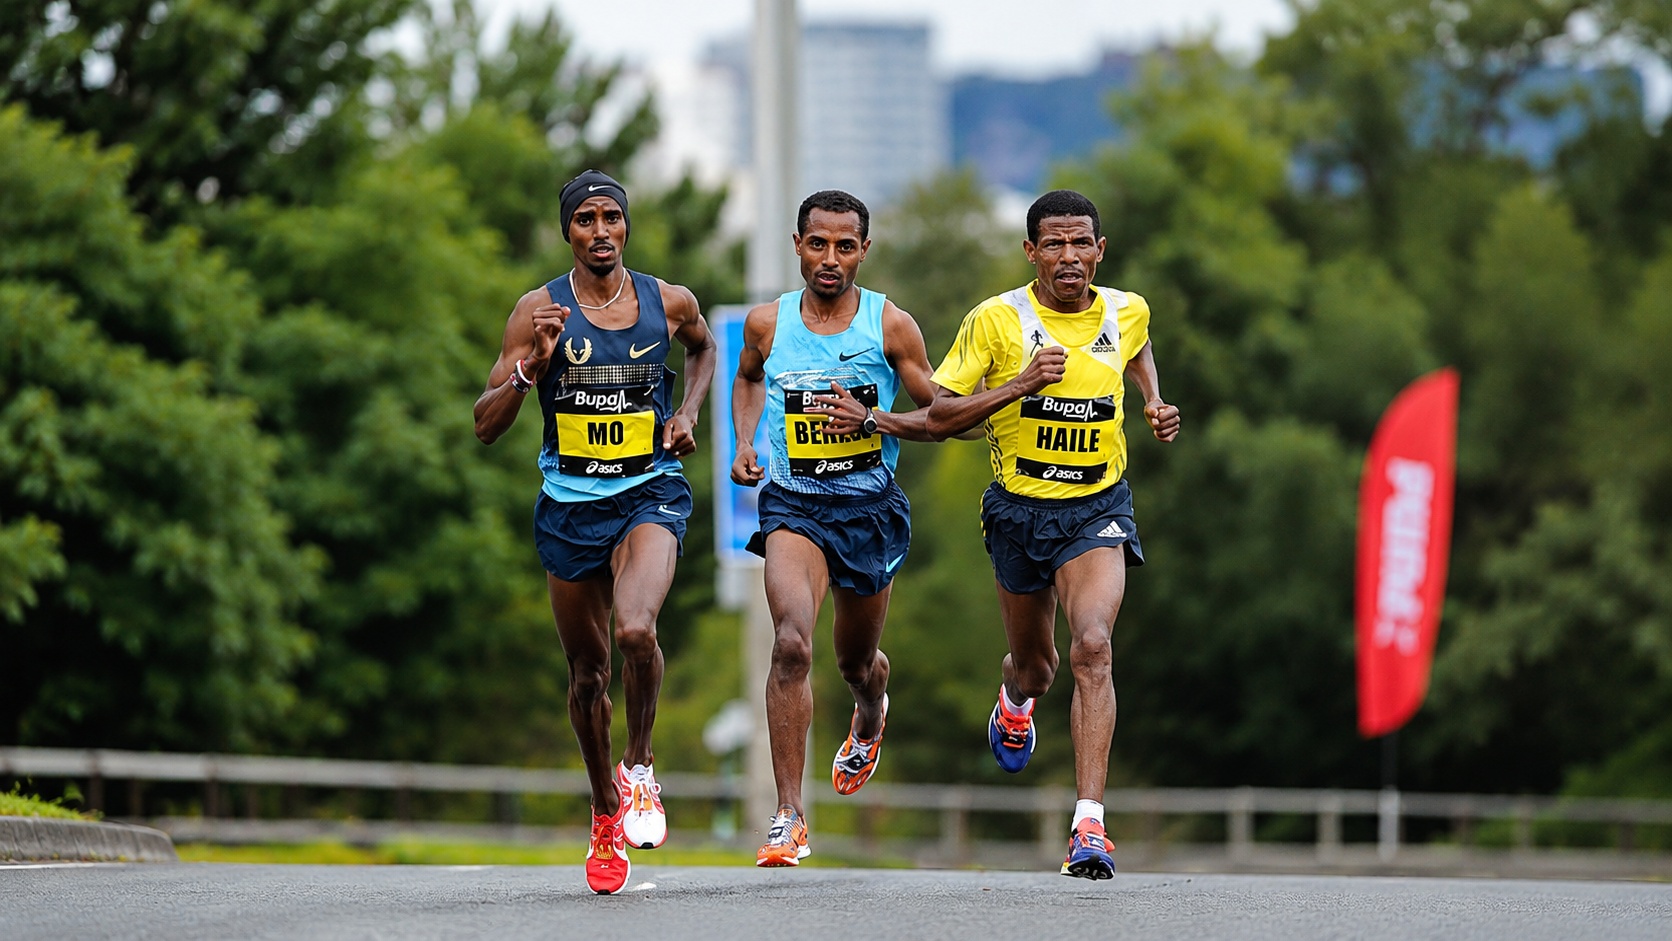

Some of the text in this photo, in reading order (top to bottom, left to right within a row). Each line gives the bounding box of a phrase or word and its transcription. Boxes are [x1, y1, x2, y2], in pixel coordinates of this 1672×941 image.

[574, 391, 618, 409] Bupa
[1042, 397, 1086, 416] Bupa
[587, 420, 624, 446] MO
[1036, 426, 1100, 453] HAILE
